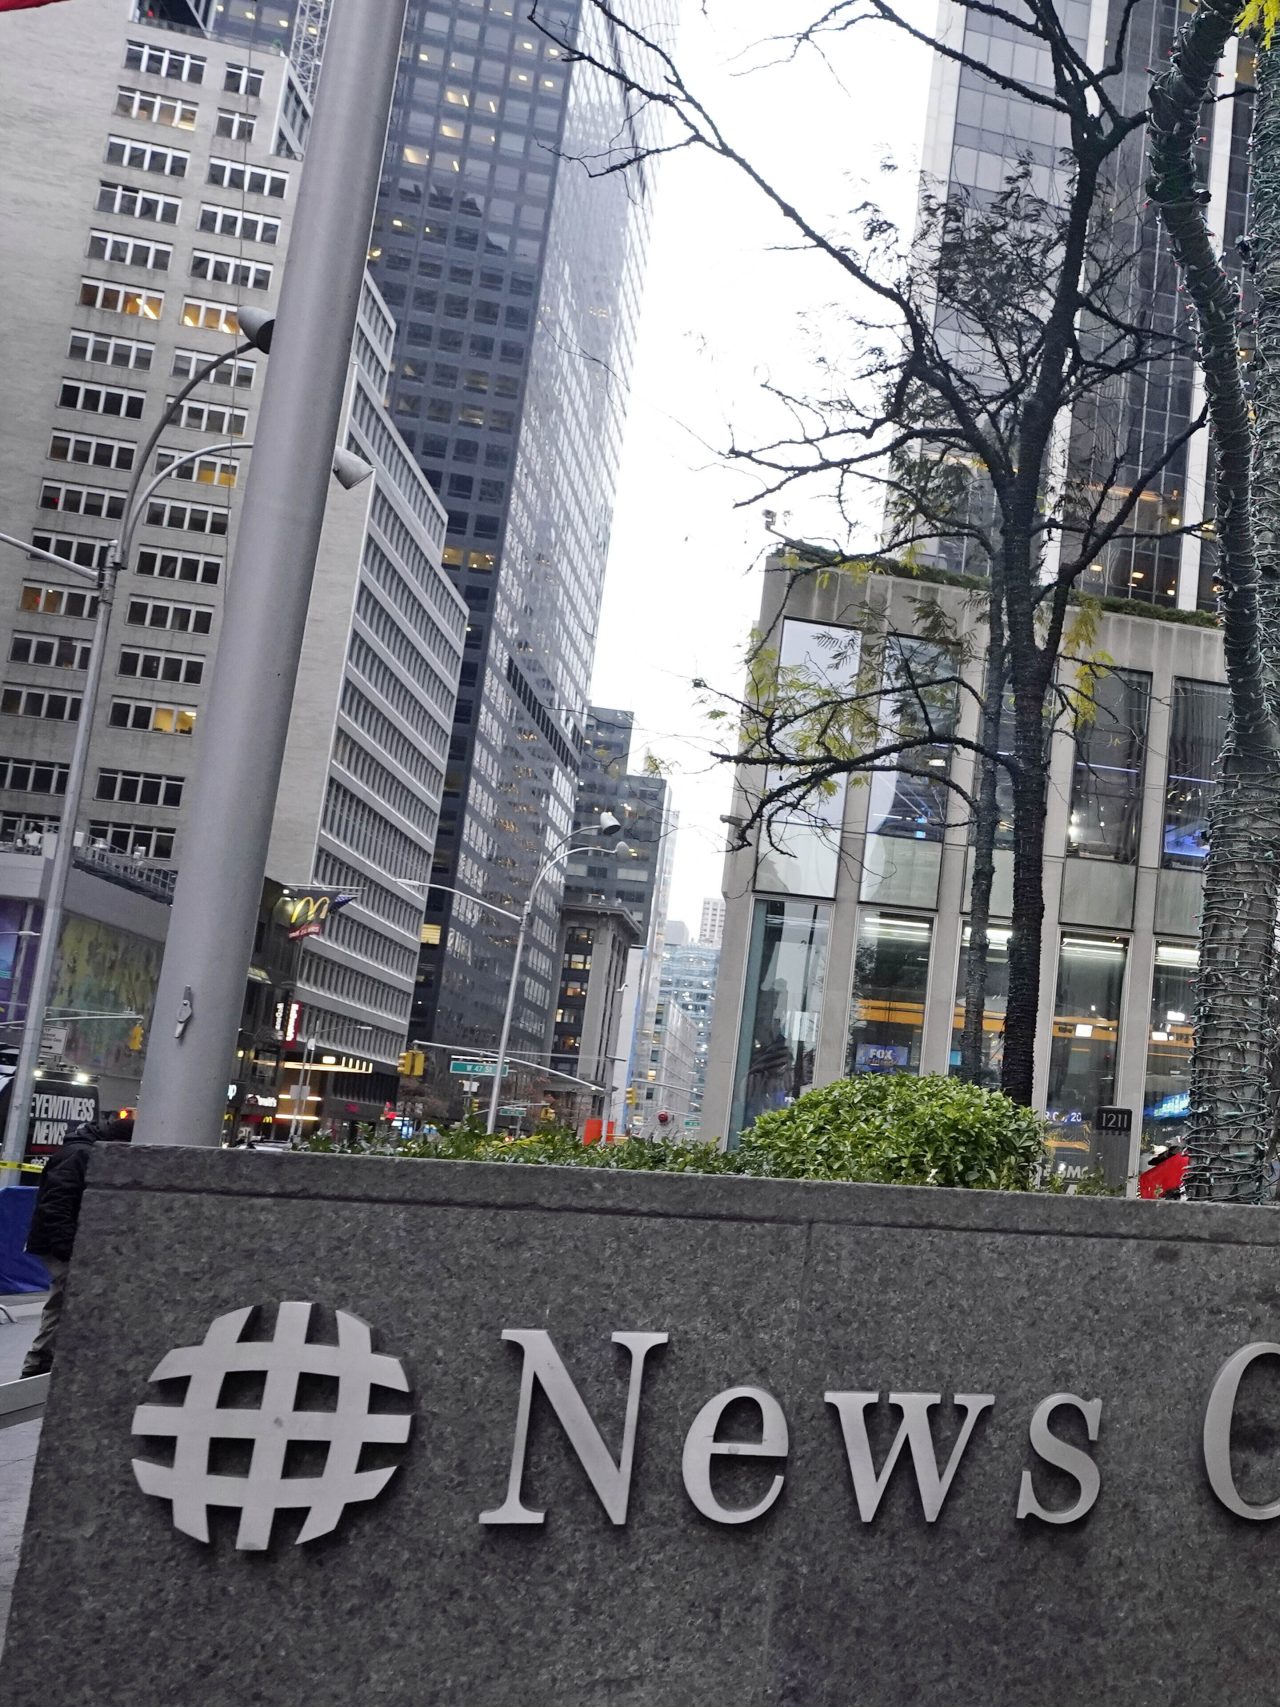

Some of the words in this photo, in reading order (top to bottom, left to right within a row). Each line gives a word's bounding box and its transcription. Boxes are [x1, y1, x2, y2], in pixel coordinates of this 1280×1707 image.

[869, 1048, 894, 1060] FOX
[30, 1094, 95, 1122] EYEWITNESS
[32, 1121, 68, 1145] NEWS
[1102, 1113, 1128, 1129] 1211
[478, 1328, 1104, 1527] News
